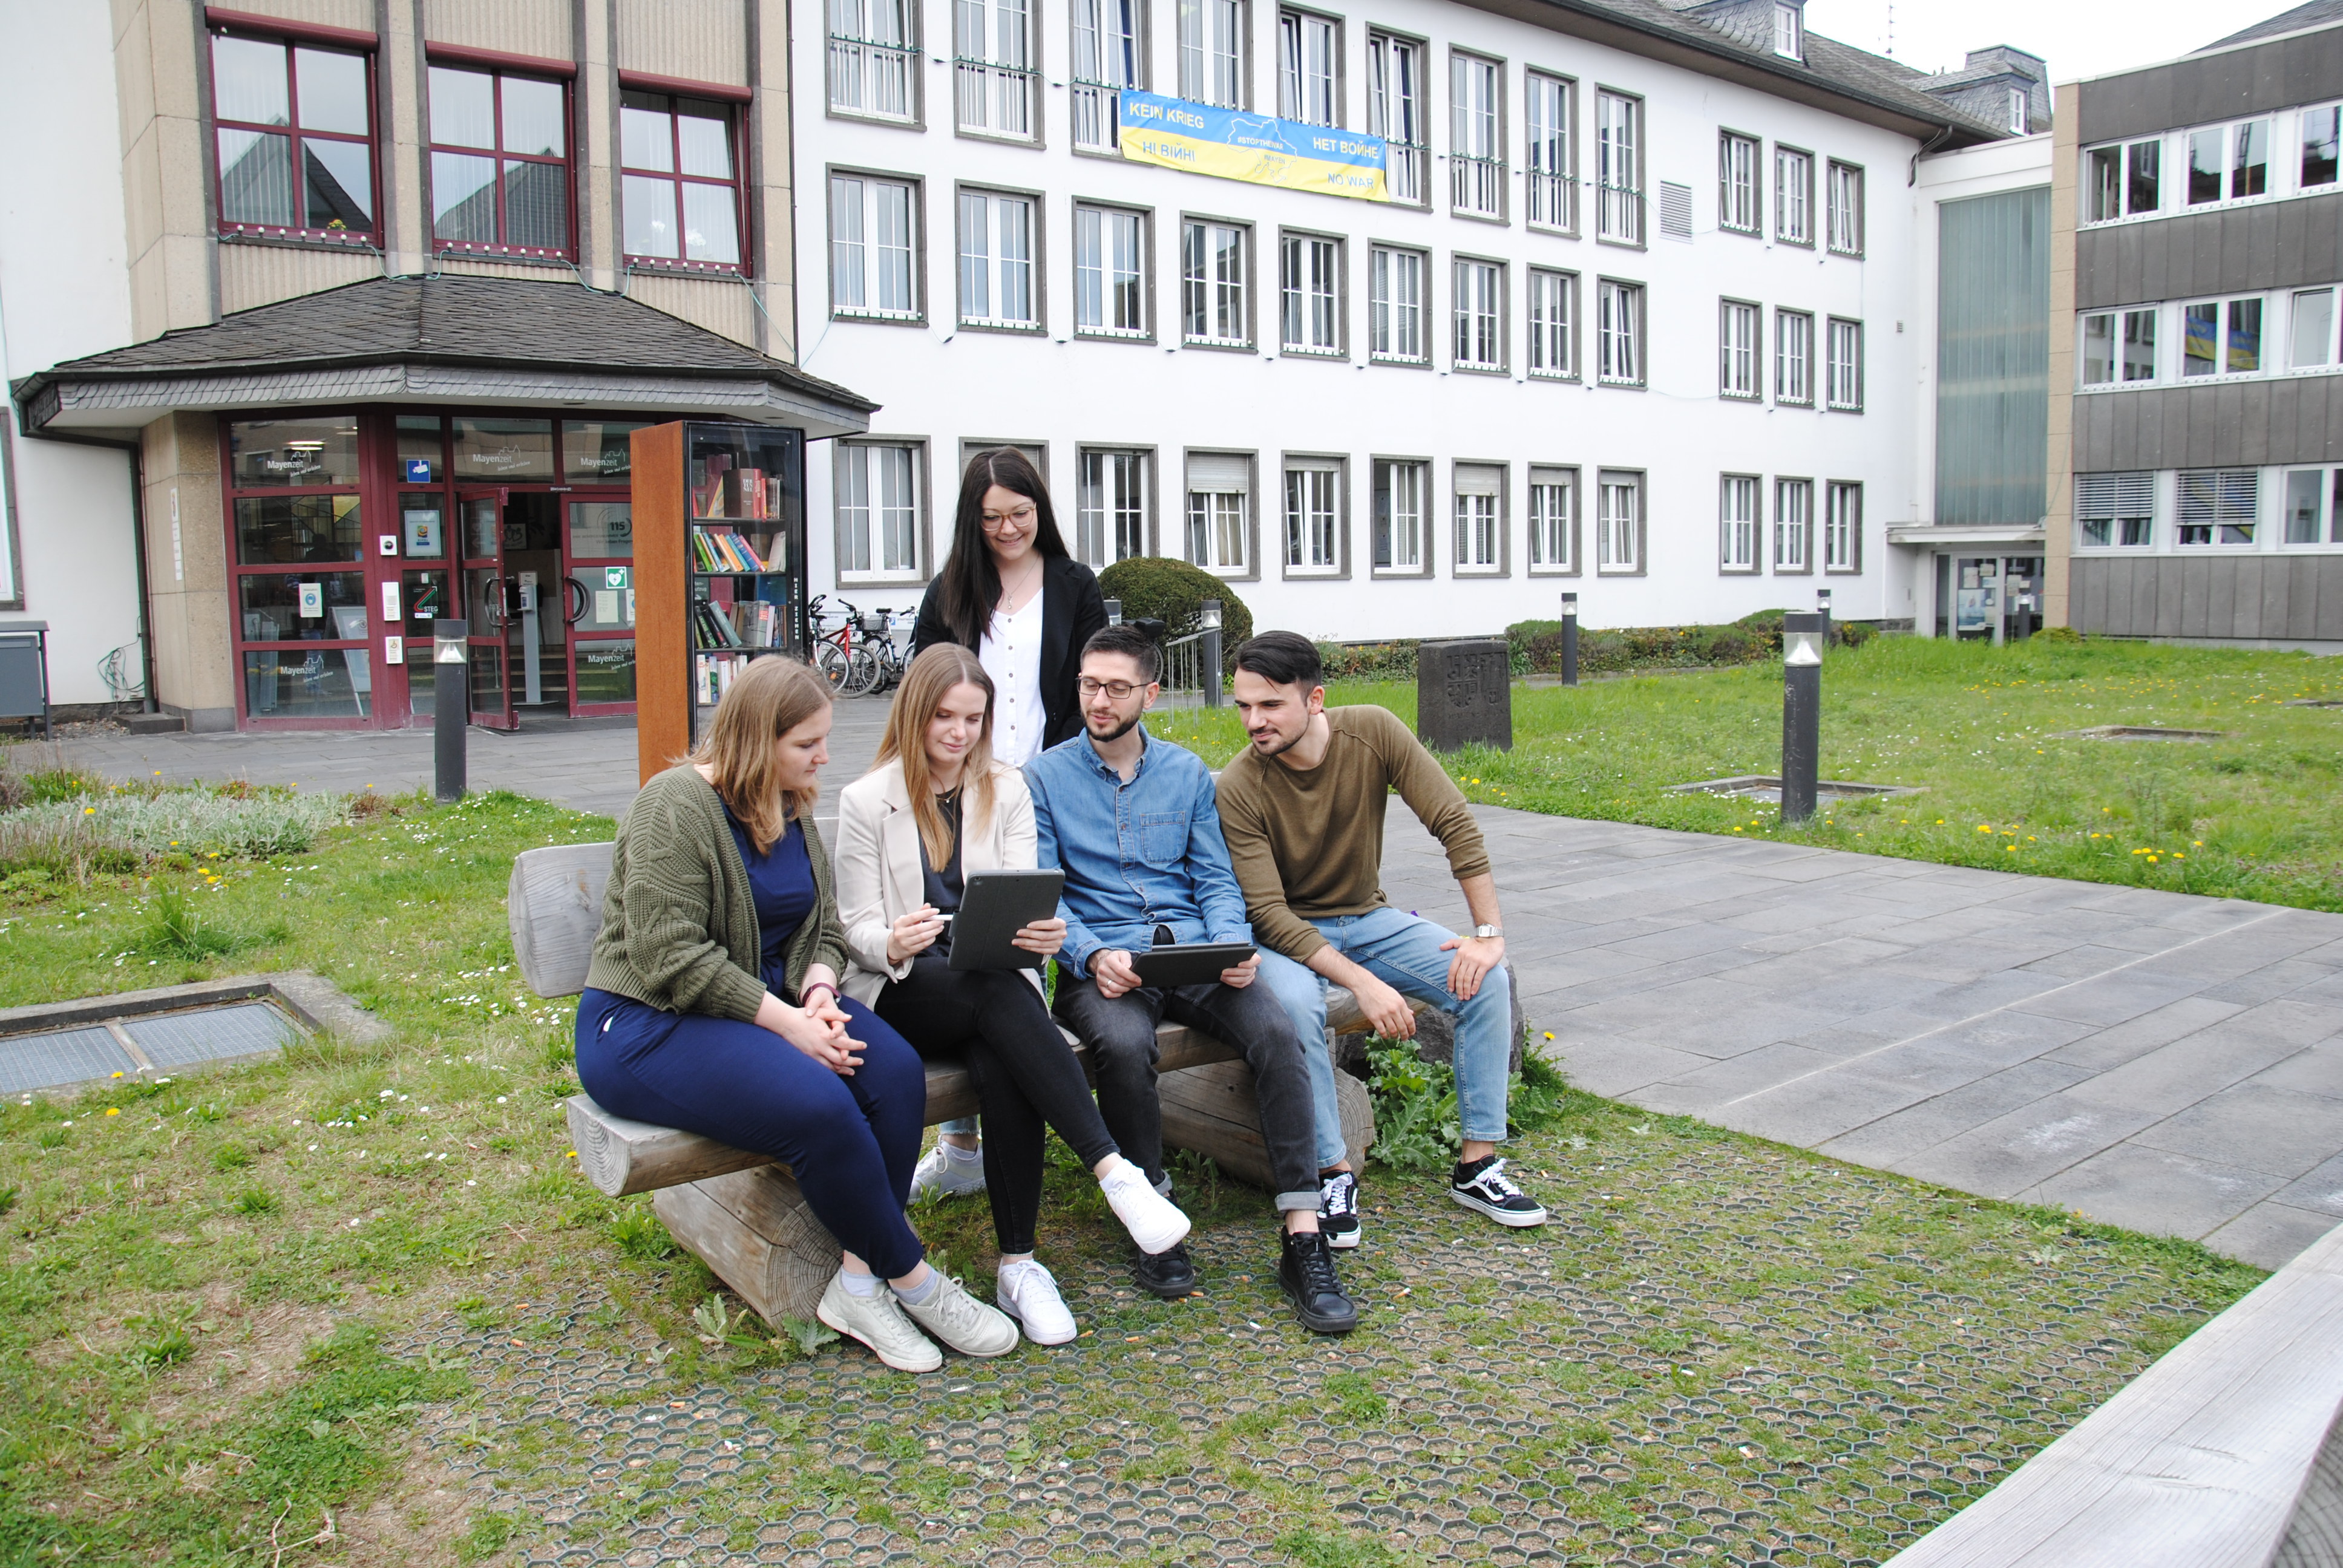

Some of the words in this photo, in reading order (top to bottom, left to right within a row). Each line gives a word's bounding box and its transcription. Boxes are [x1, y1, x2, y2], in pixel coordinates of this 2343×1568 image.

[1130, 102, 1163, 120] KEIN
[1167, 108, 1204, 129] KRIEG
[1237, 136, 1283, 150] #STOPTHEWAR
[1313, 137, 1336, 152] НЕТ
[1340, 140, 1378, 159] ВОЙНЕ
[1143, 141, 1156, 155] НІ
[1161, 142, 1195, 162] ВІЙНІ
[1264, 154, 1285, 165] #MAYEN
[1328, 172, 1343, 185] NO
[1346, 175, 1374, 189] WAR
[474, 454, 512, 465] Mayenzeit
[581, 457, 618, 468] Mayenzeit
[267, 460, 303, 471] Mayenzeit
[610, 521, 625, 531] 115
[588, 653, 624, 664] Mayenzeit
[280, 665, 316, 676] Mayenzeit
